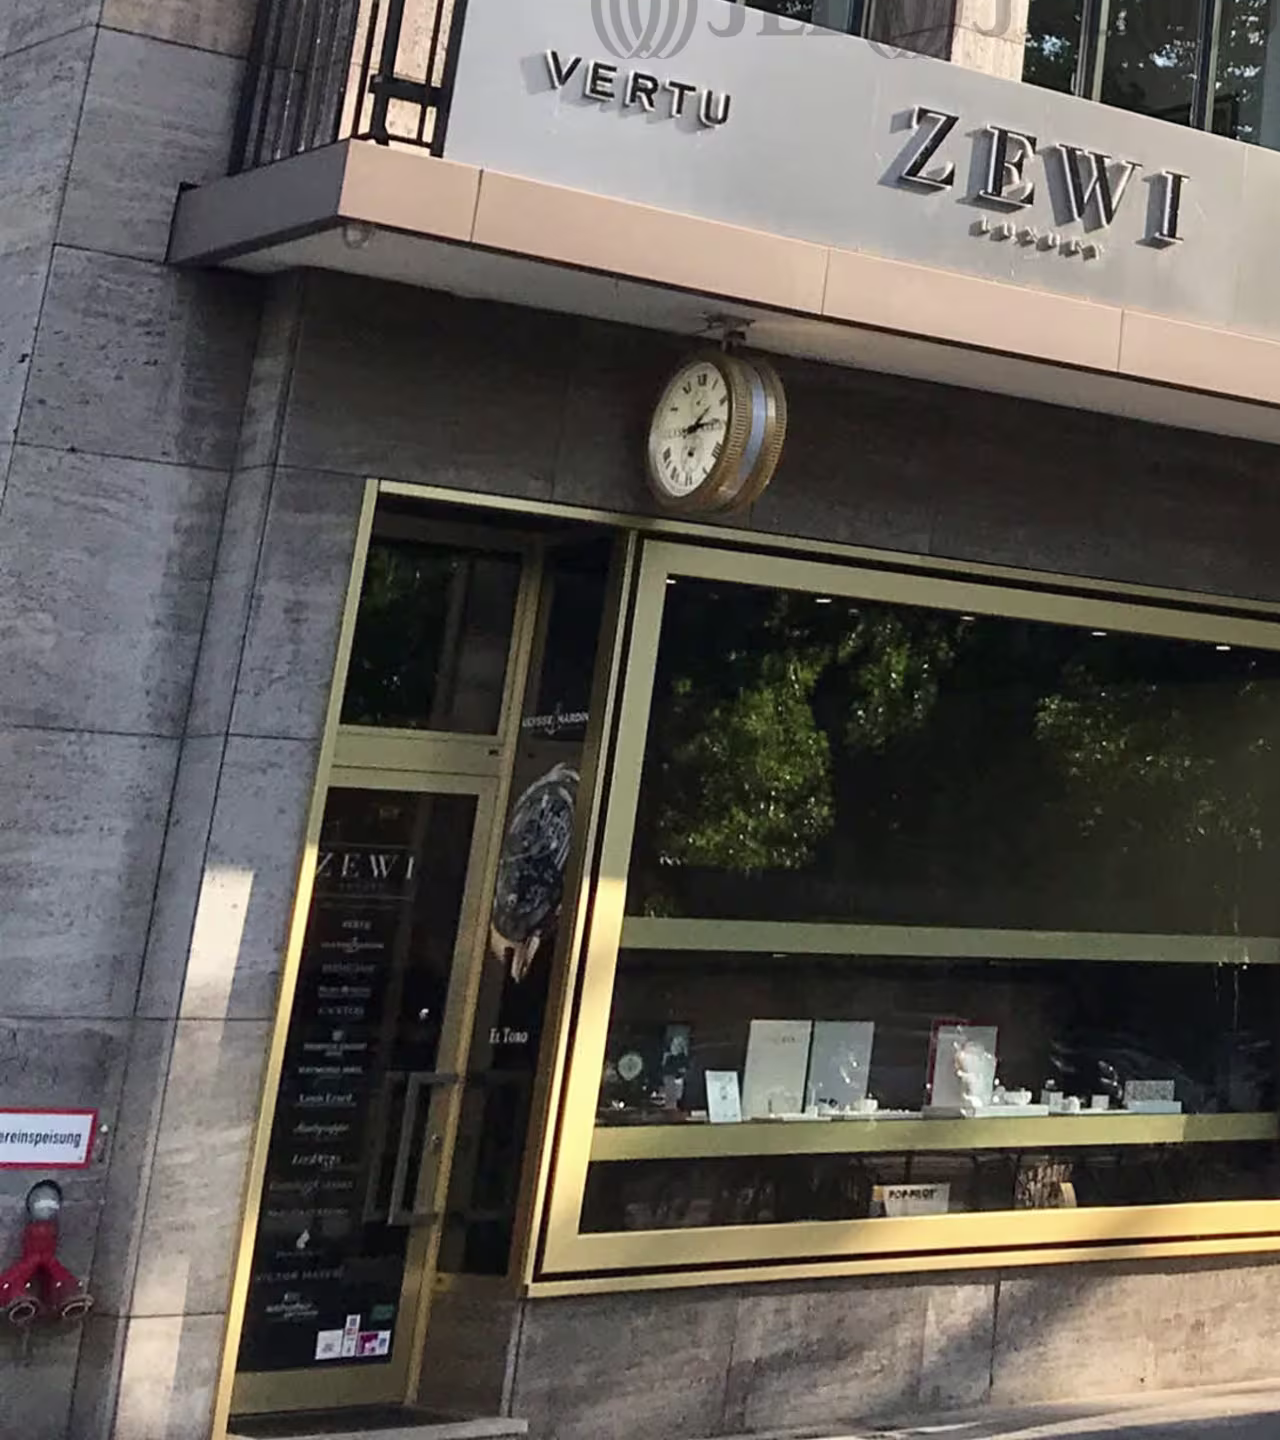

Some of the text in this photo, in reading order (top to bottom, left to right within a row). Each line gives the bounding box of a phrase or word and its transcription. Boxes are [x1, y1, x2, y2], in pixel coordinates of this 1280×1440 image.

[544, 49, 732, 126] VERTU
[902, 106, 1191, 241] ZEWI
[317, 851, 415, 881] ZEWI
